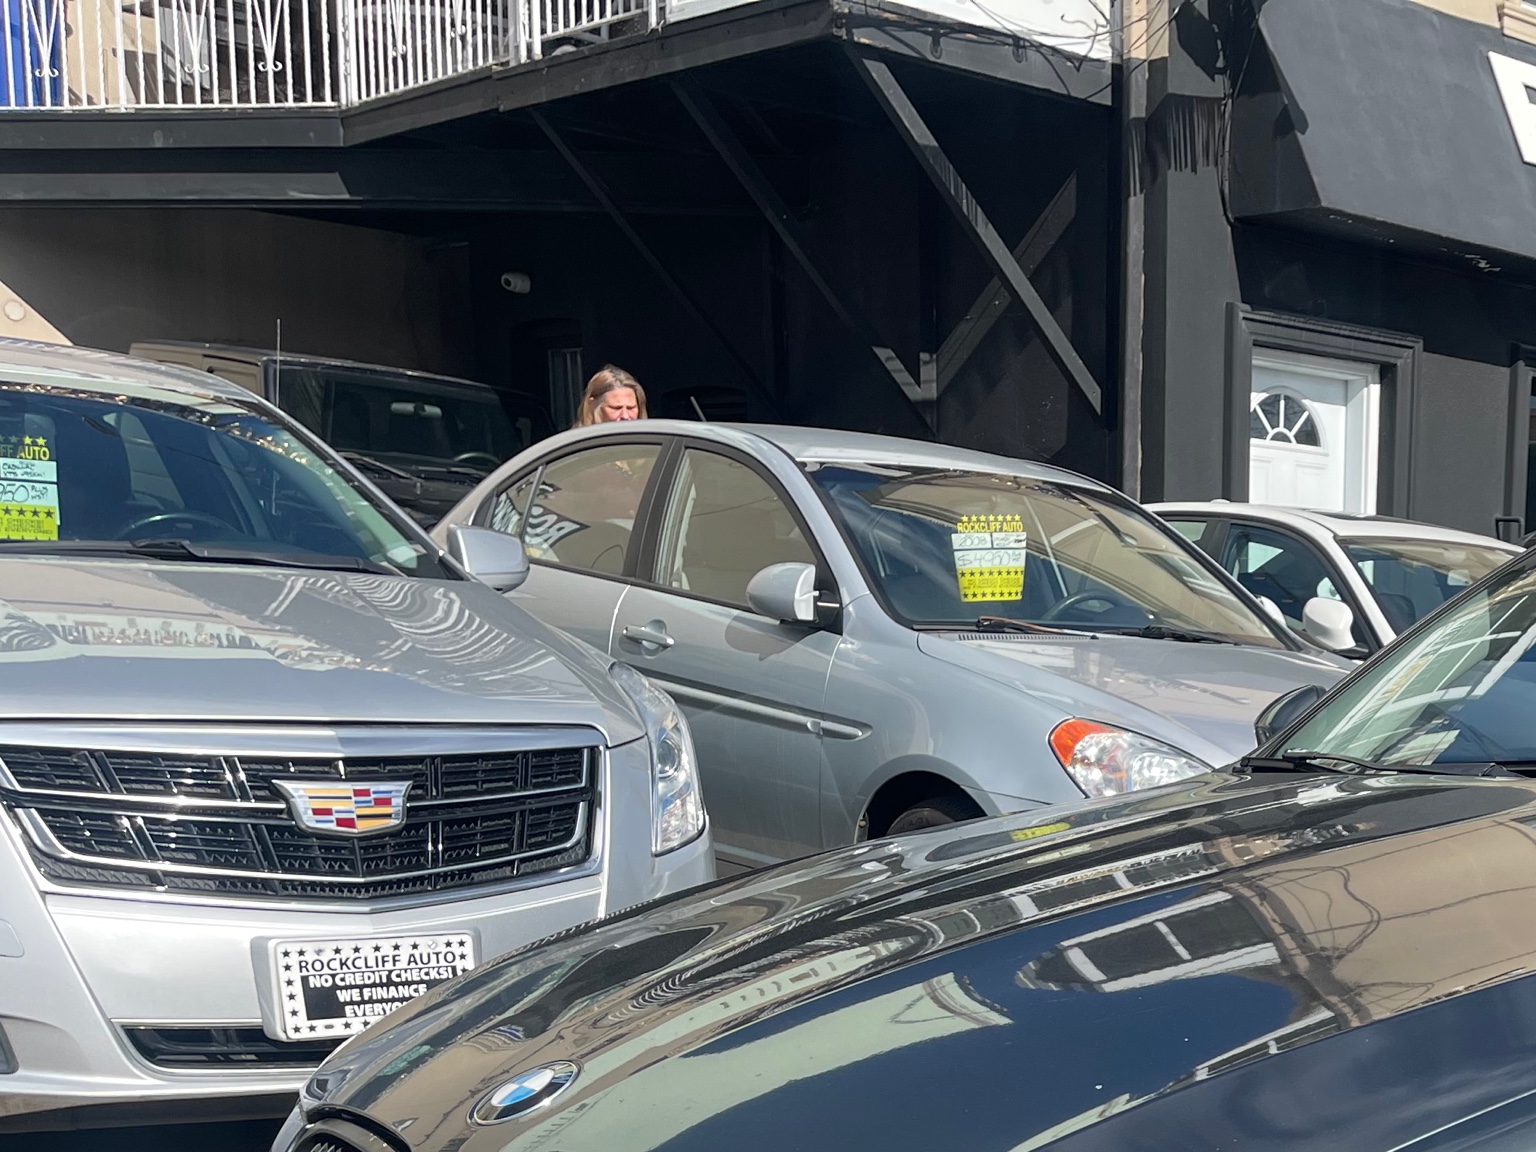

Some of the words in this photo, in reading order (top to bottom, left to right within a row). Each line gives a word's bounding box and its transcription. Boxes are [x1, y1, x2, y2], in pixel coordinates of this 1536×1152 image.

[957, 522, 1000, 533] ROCKCLIFF
[1003, 521, 1023, 532] AUTO
[300, 953, 402, 973] ROCKCLIFF
[407, 951, 456, 966] AUTO
[308, 974, 333, 989] NO
[334, 970, 389, 986] CREDIT
[391, 966, 453, 982] CHECKS!
[336, 988, 361, 1002] WE
[363, 983, 428, 1000] FINANCE
